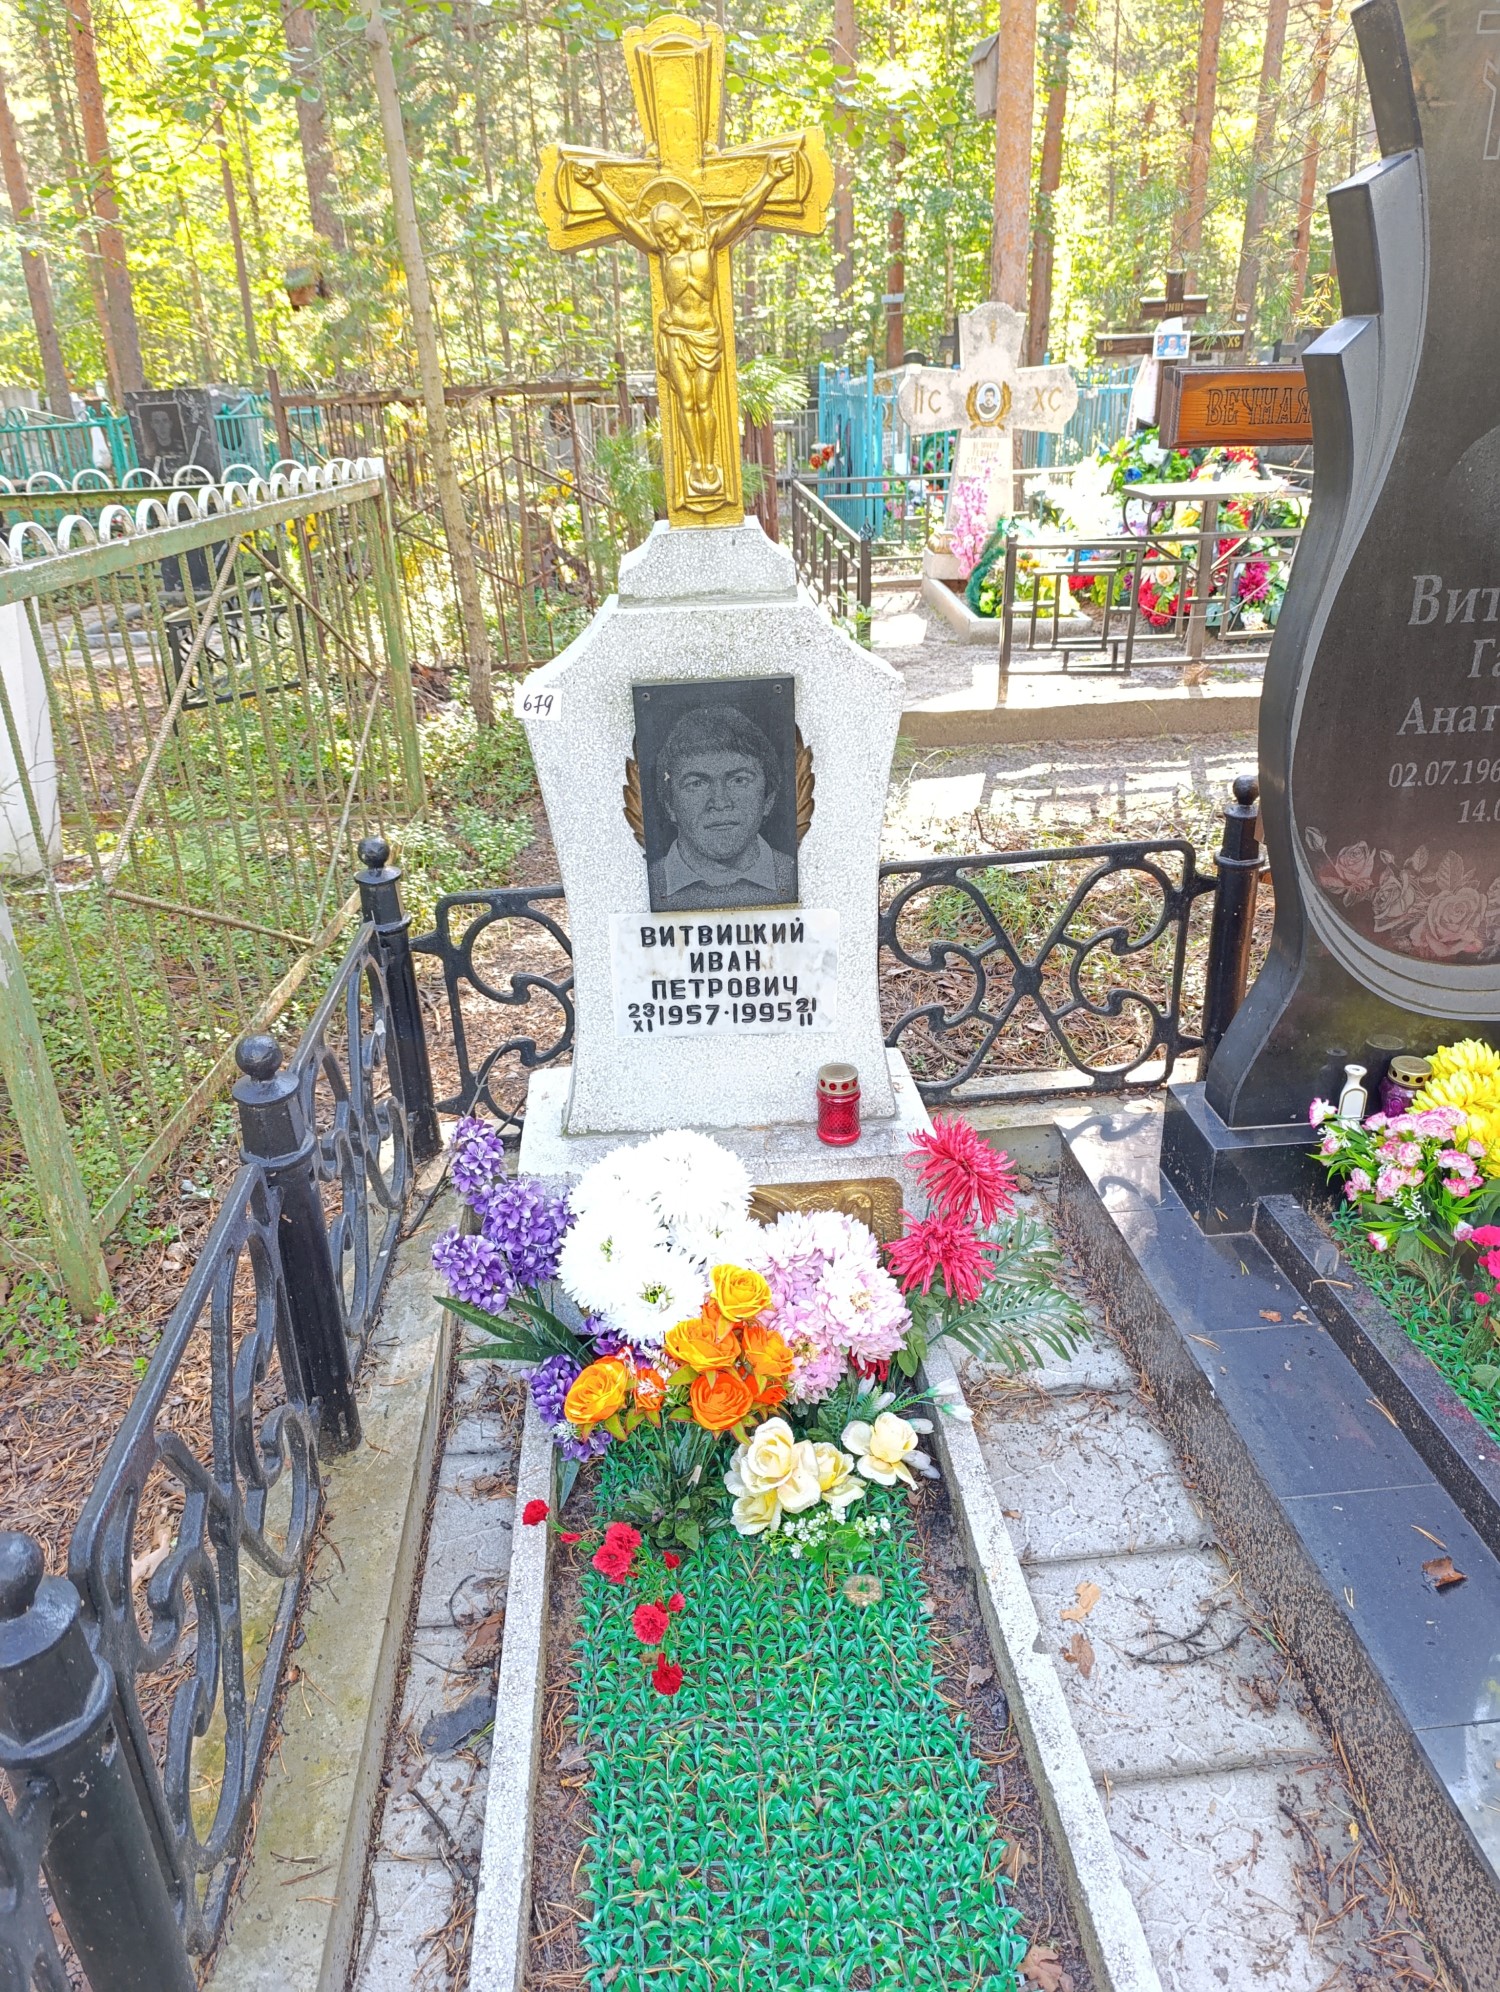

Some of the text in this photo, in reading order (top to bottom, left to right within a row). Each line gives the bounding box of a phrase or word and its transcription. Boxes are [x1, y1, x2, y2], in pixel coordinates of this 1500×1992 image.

[1205, 387, 1312, 426] ВЕЧНАЯ
[1407, 574, 1500, 626] Вит
[523, 694, 554, 717] 679
[1396, 696, 1500, 736] Анат
[1388, 758, 1500, 788] 02.07.196
[640, 917, 805, 948] ВИТВИЦКИЙ
[689, 950, 761, 974] ИВАН
[651, 975, 798, 1000] ПЕТРОВИЧ
[627, 1002, 656, 1019] 23
[795, 997, 817, 1013] 21
